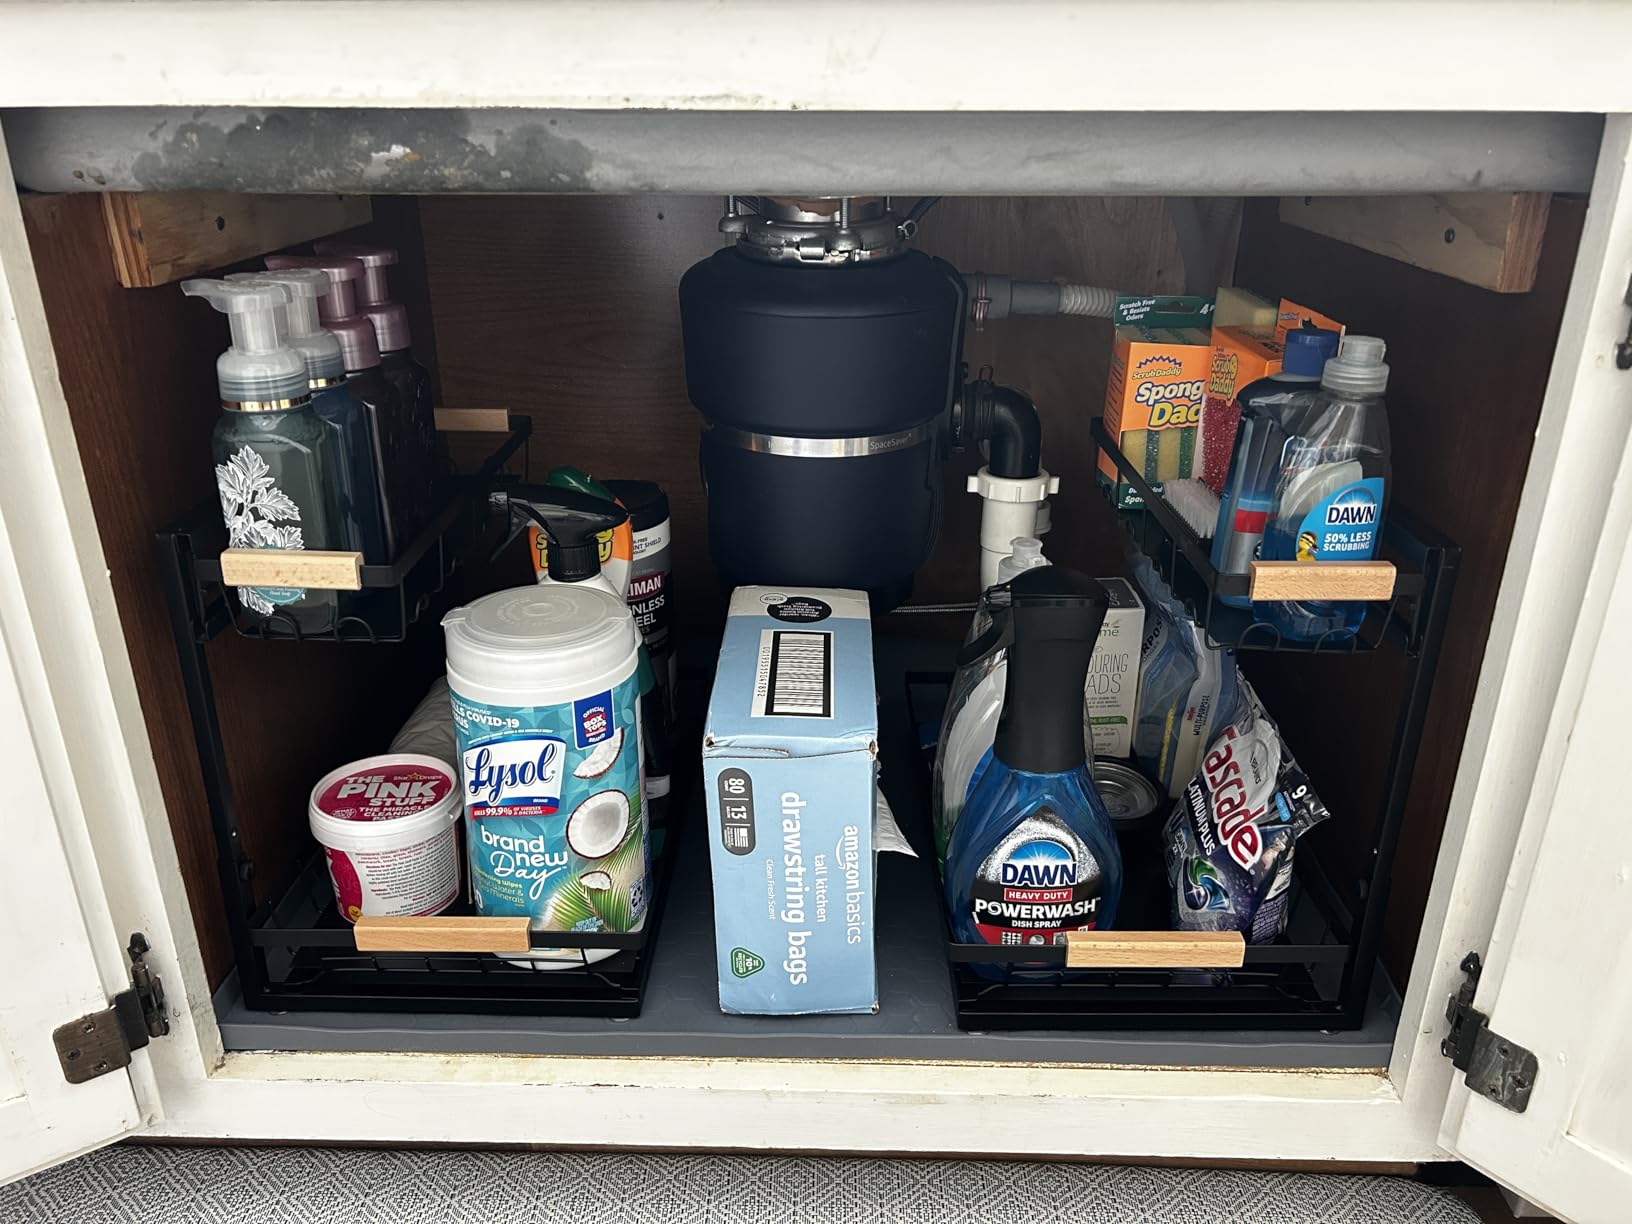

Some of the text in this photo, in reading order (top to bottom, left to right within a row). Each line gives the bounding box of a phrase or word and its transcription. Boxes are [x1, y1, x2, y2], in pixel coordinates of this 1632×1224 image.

[1120, 299, 1156, 311] Scratch Free
[1200, 303, 1210, 315] 4
[1126, 313, 1144, 321] Odors
[1211, 353, 1231, 373] Scrub
[1209, 374, 1235, 400] Daddy
[1327, 505, 1376, 524] DAWN
[645, 538, 661, 549] SHIELD
[1324, 532, 1371, 543] 50% LESS
[1323, 542, 1370, 551] SCRUBBING
[632, 595, 664, 615] NLESS
[466, 710, 520, 728] COVID-19
[583, 706, 605, 718] OFFICIAL
[583, 714, 603, 729] BOX
[587, 720, 606, 733] TOPS
[346, 775, 386, 784] THE
[466, 743, 556, 803] Lysol
[337, 781, 441, 798] PINK
[728, 778, 745, 794] 80
[1292, 785, 1307, 800] 9
[369, 796, 435, 806] STUFF
[485, 806, 512, 817] 99.9%
[731, 806, 747, 819] 13
[480, 826, 545, 853] brand
[1198, 824, 1216, 856] PLUS
[516, 851, 568, 867] new
[490, 851, 562, 900] Day
[766, 859, 774, 879] Clean
[1002, 863, 1077, 885] DAWN
[502, 879, 522, 889] wipes
[781, 791, 812, 985] drawstring bags
[815, 853, 829, 923] tall kitchen
[843, 825, 864, 944] amazon basics
[1009, 891, 1068, 900] HEAVY DUTY
[768, 900, 776, 920] Scent
[975, 899, 1096, 919] POWERWASH
[1012, 920, 1062, 928] DISH SPRAY
